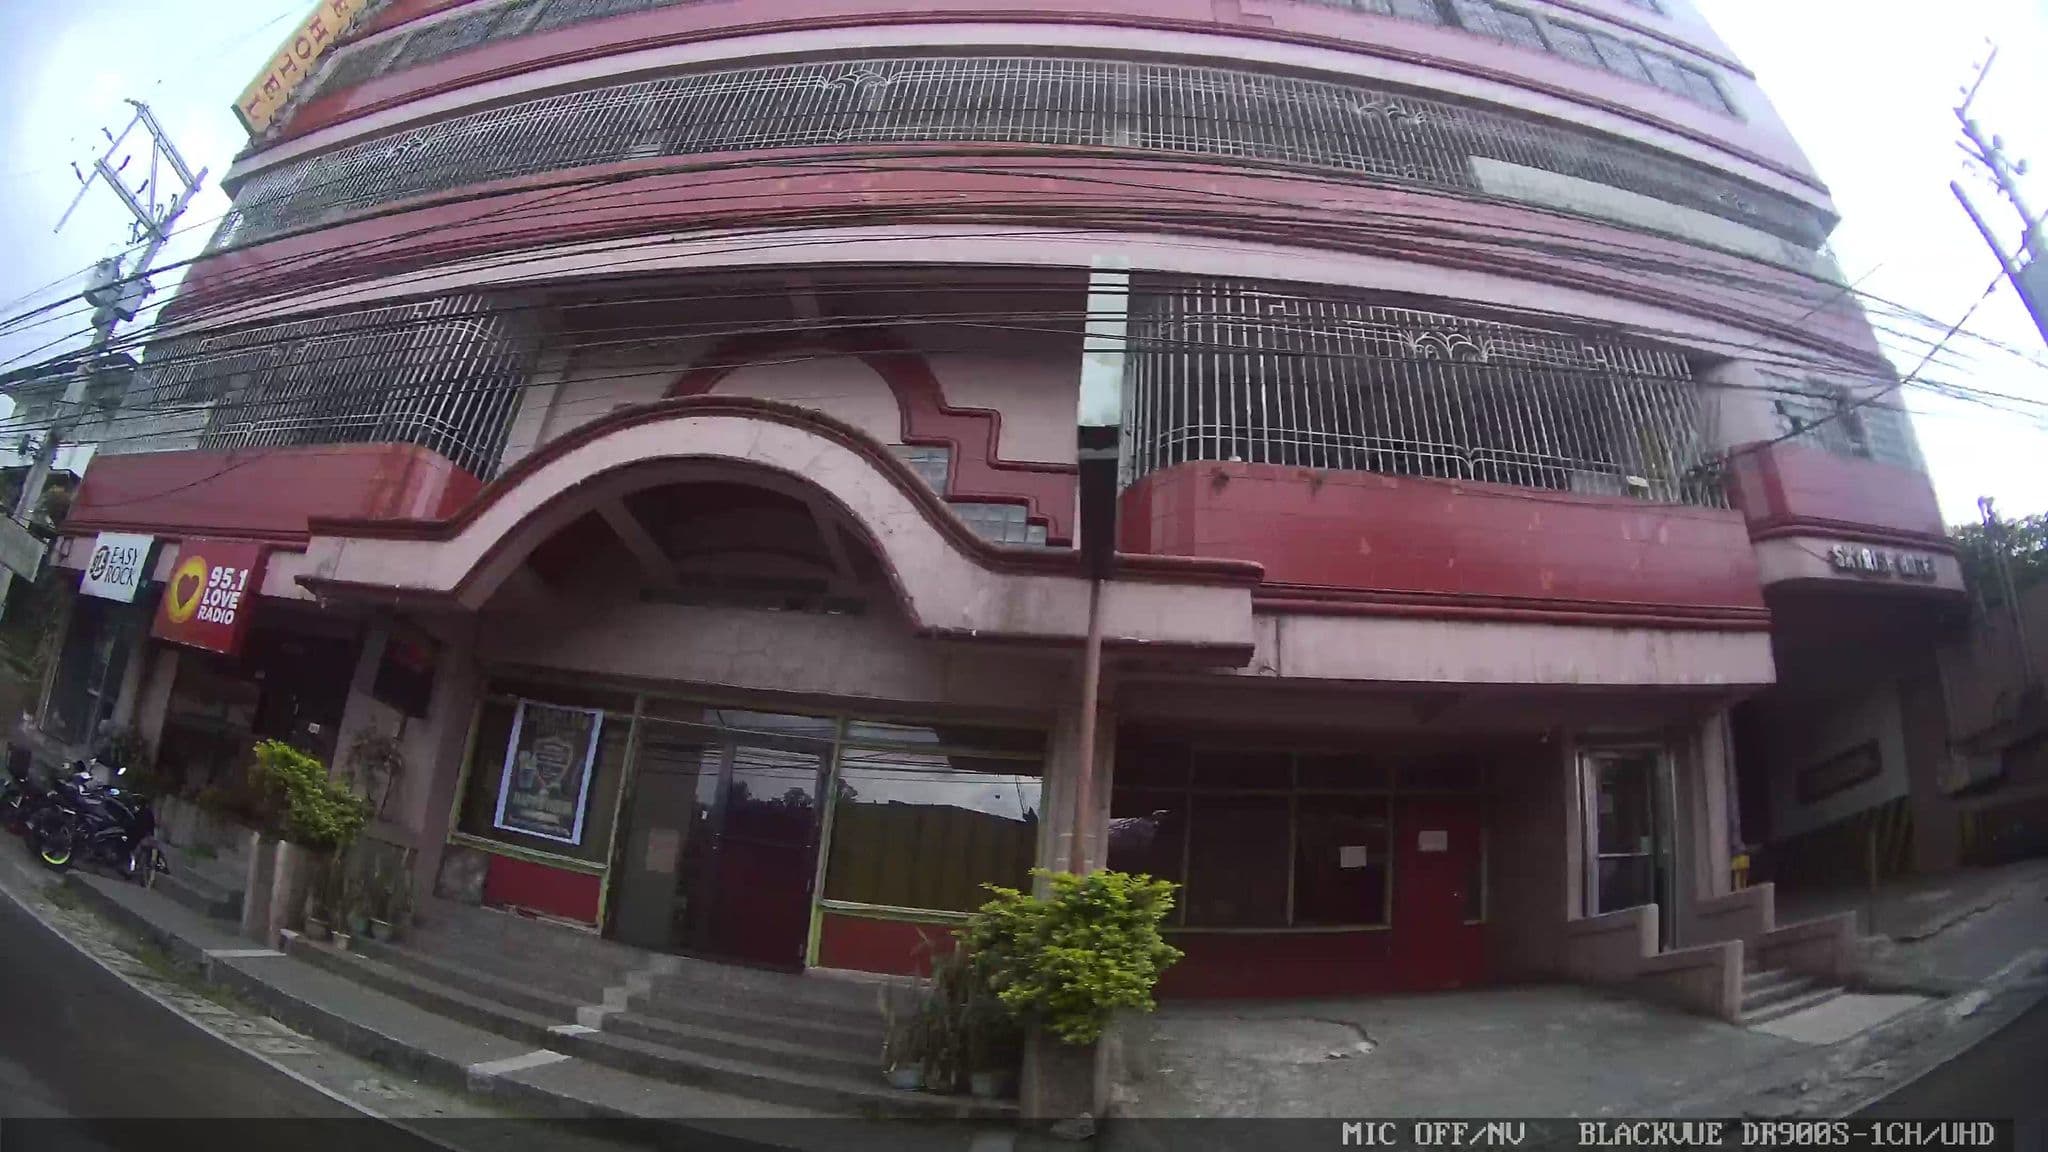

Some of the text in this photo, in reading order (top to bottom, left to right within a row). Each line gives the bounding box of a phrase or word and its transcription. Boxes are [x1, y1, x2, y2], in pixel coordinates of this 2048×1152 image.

[246, 15, 329, 120] HOTEL
[110, 546, 138, 567] EASY
[104, 564, 134, 586] ROCK
[209, 566, 249, 590] 95.1
[202, 587, 241, 610] LOVE
[197, 605, 235, 625] RADIO
